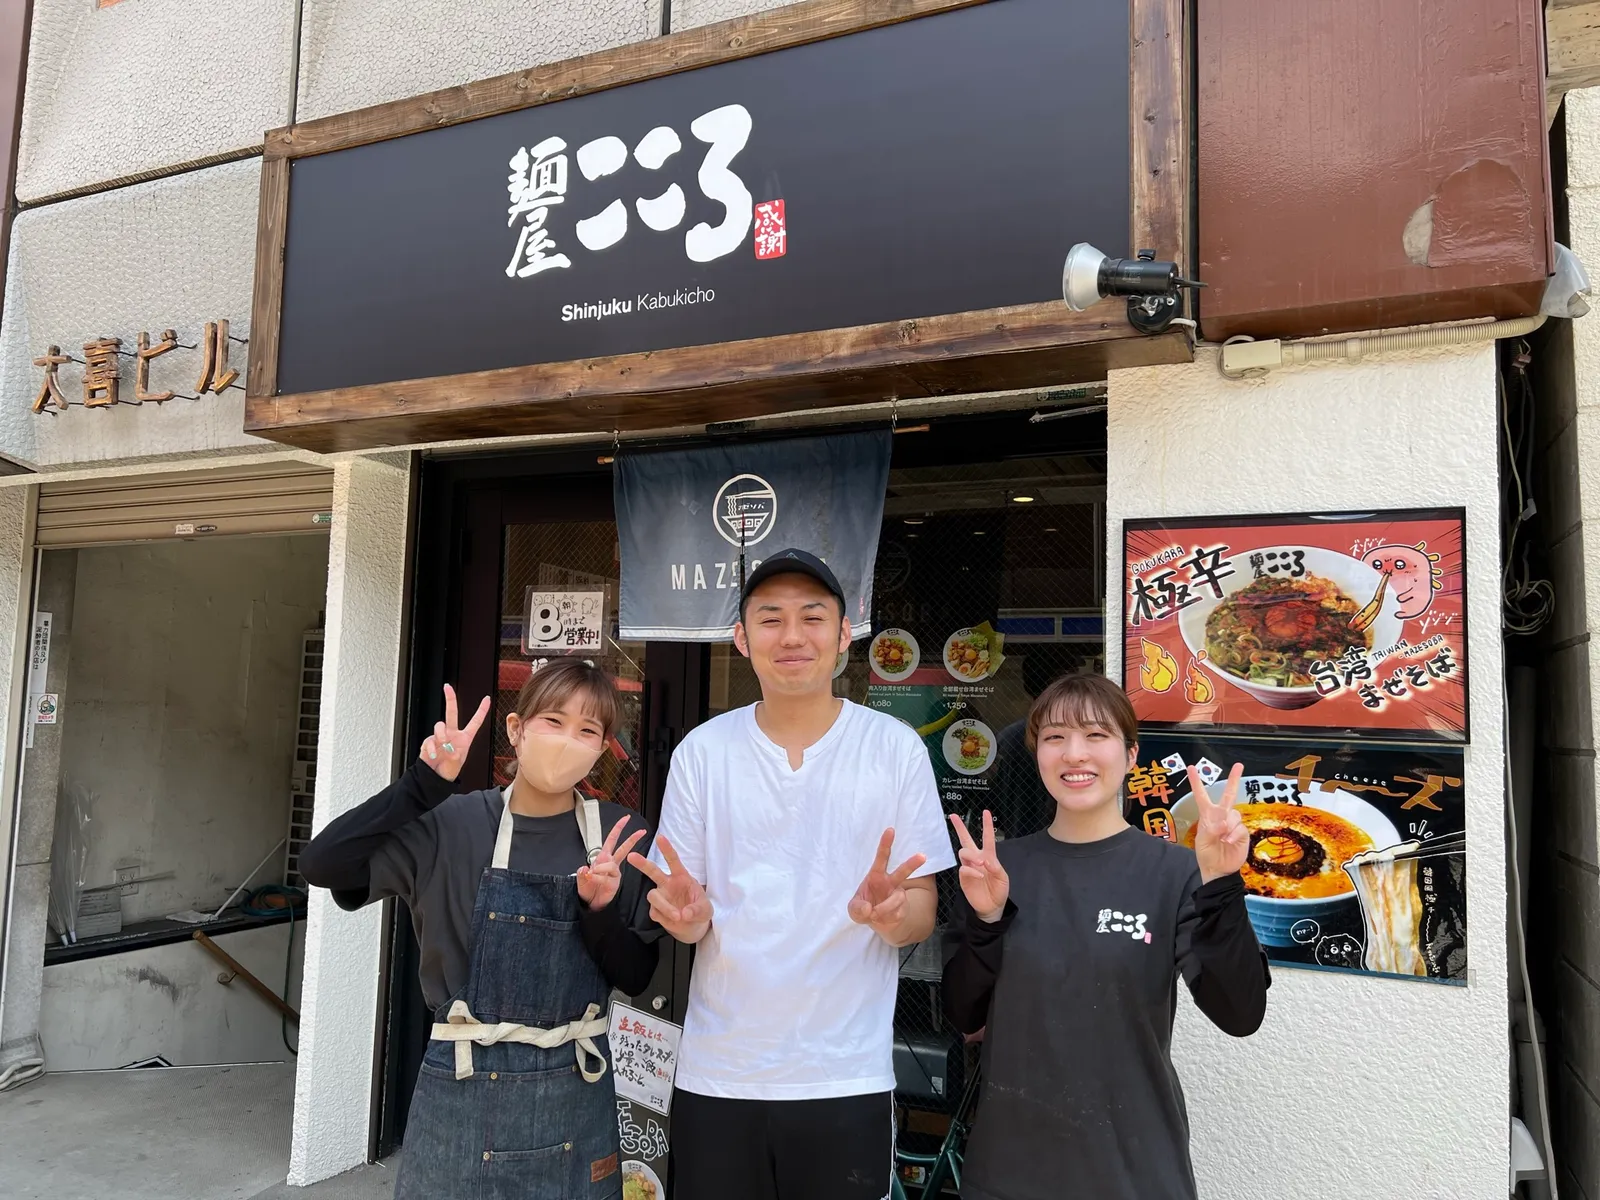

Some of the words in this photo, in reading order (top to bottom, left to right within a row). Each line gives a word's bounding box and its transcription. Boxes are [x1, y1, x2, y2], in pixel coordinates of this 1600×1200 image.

[561, 298, 632, 322] Shinjuku
[637, 286, 715, 312] Kabukicho
[1131, 546, 1185, 575] GOKUKARA
[1131, 546, 1236, 626] 極辛
[532, 603, 563, 643] 8
[1309, 646, 1372, 695] 台湾
[1371, 639, 1408, 661] TAIWAN
[1358, 646, 1457, 708] まぜそば
[1127, 760, 1177, 843] 韓国
